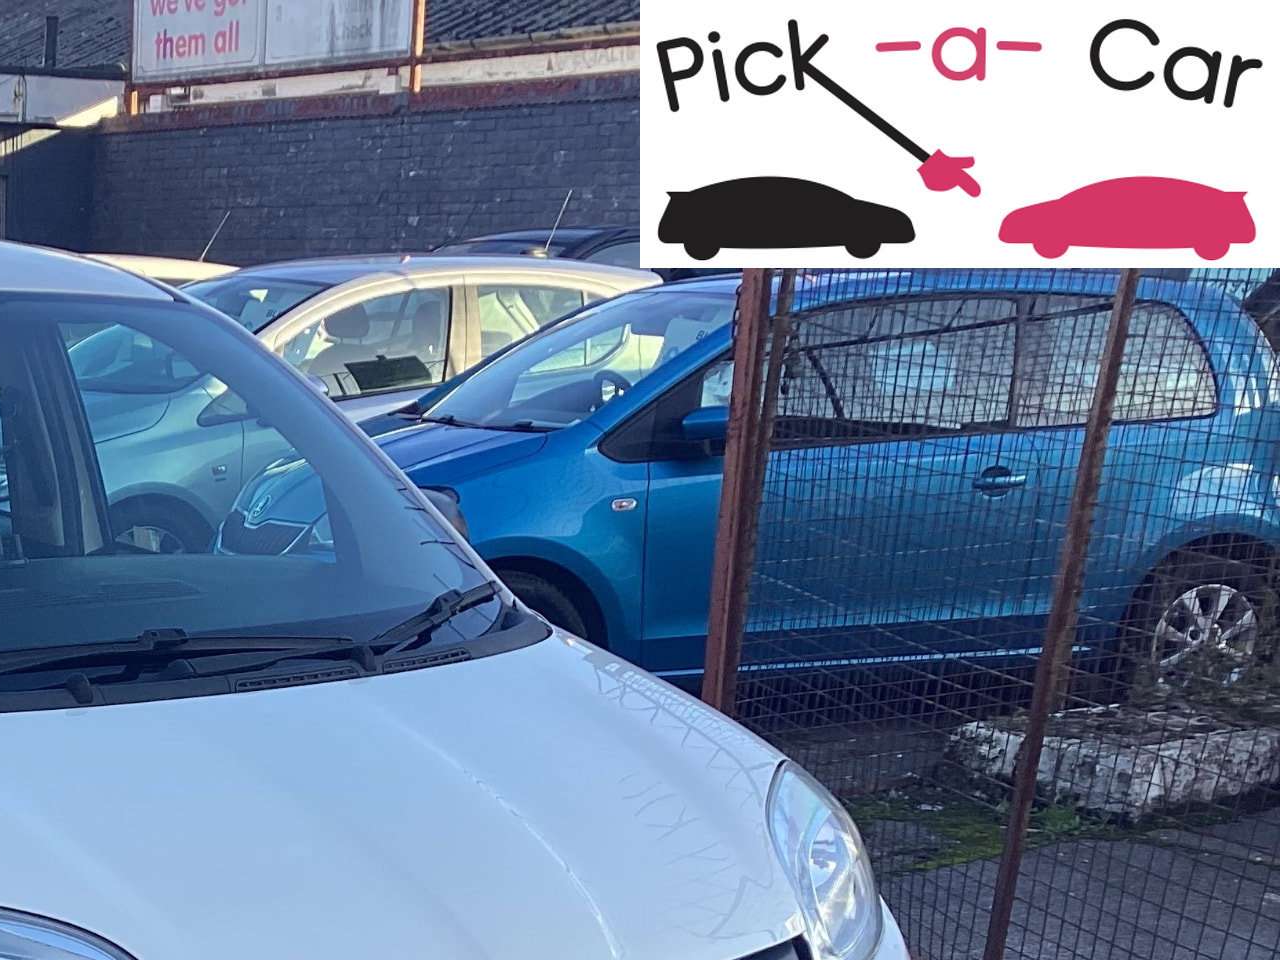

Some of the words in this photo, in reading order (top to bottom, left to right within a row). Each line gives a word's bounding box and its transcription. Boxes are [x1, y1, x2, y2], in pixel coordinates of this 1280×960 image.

[151, 0, 205, 16] weve
[155, 28, 206, 60] them
[214, 20, 240, 54] all
